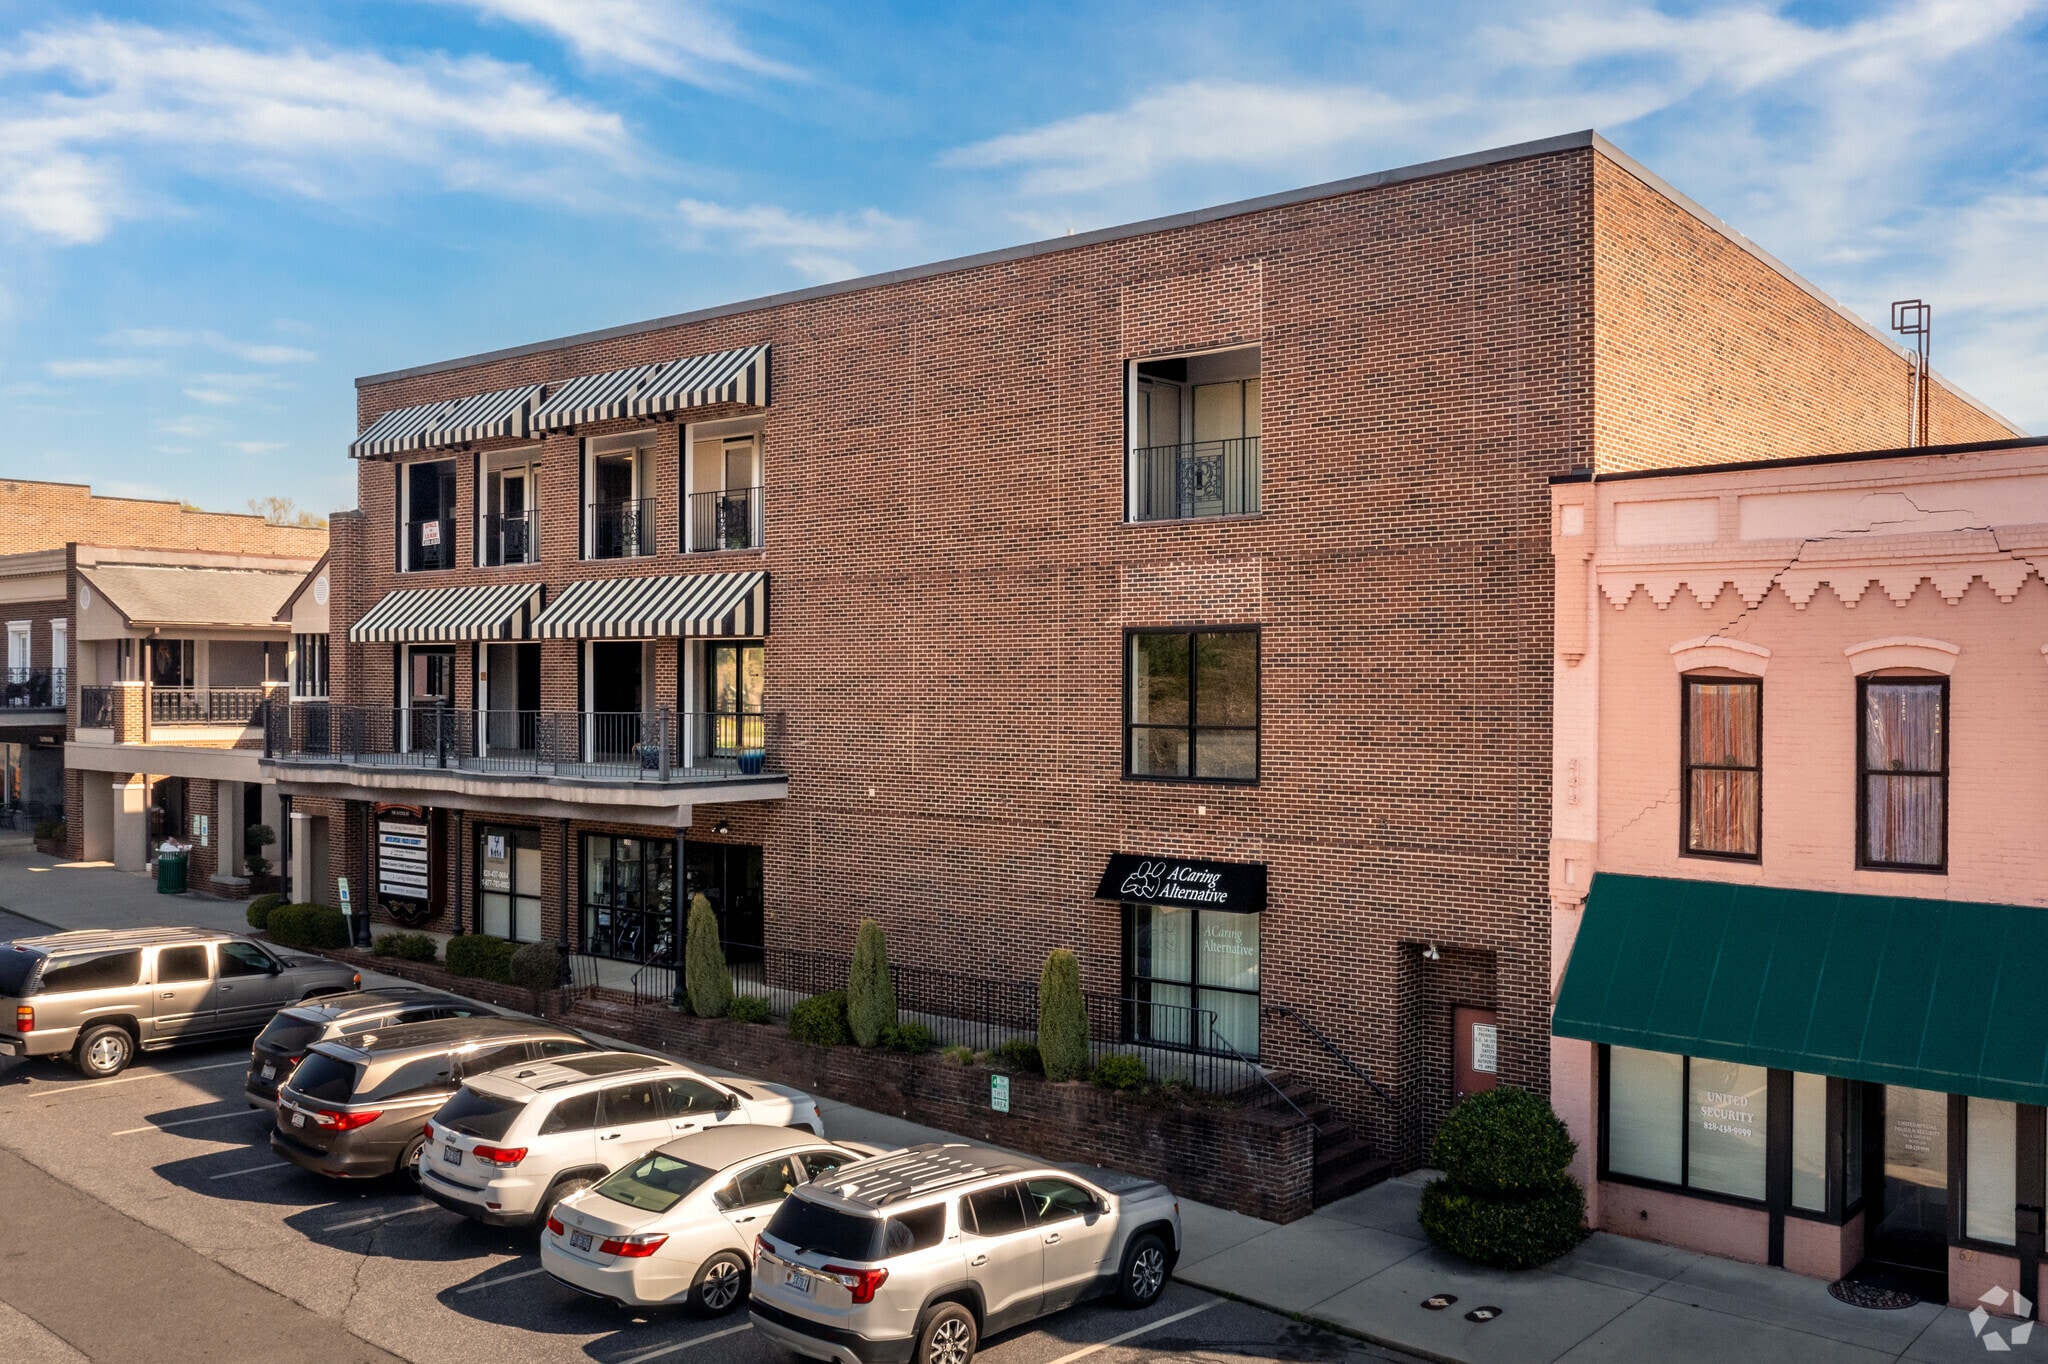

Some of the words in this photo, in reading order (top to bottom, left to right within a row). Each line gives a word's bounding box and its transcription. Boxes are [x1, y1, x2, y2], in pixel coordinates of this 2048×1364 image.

[1180, 867, 1222, 889] Caring
[1158, 883, 1228, 903] Alternative
[1211, 925, 1243, 943] Caring
[1203, 940, 1254, 956] Alternative
[994, 1090, 1006, 1098] THIS
[1707, 1091, 1748, 1107] UNITED
[1700, 1105, 1754, 1123] SECURITY
